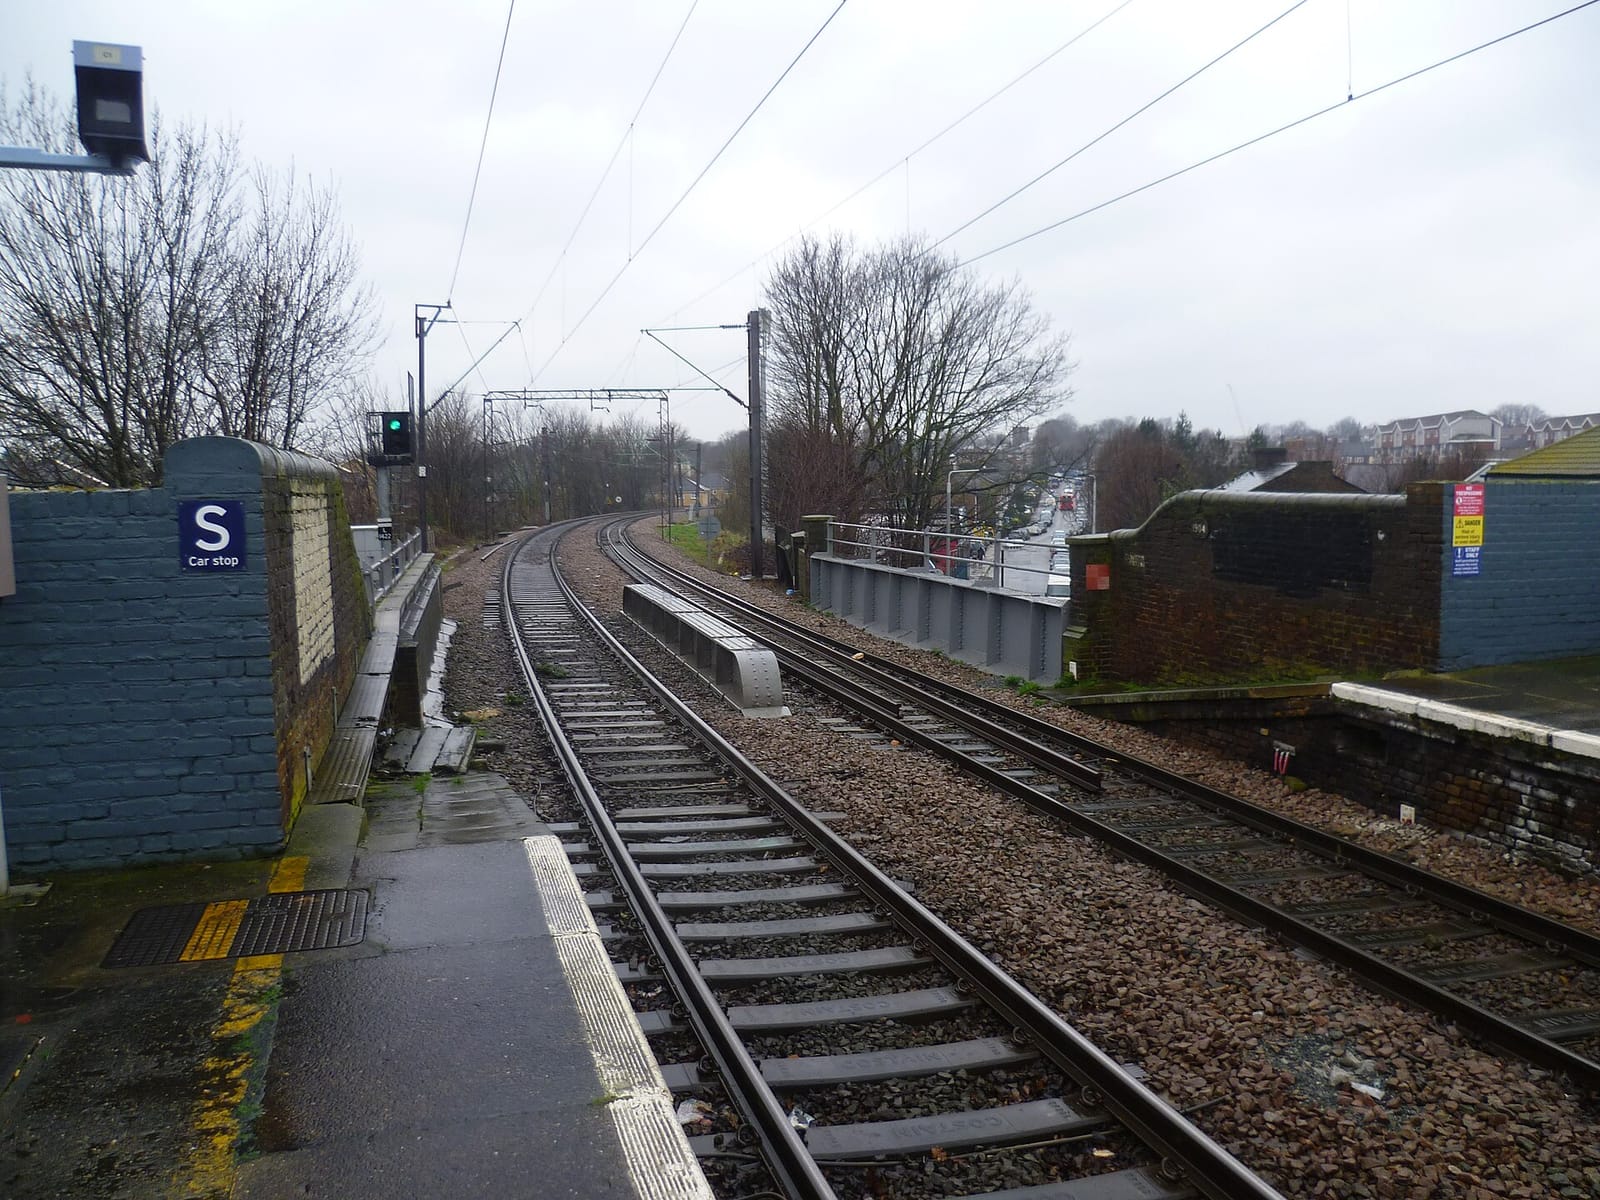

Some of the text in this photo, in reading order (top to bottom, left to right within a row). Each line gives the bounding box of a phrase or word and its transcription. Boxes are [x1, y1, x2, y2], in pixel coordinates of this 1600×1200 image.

[195, 505, 230, 551] S
[188, 555, 239, 568] Car stop
